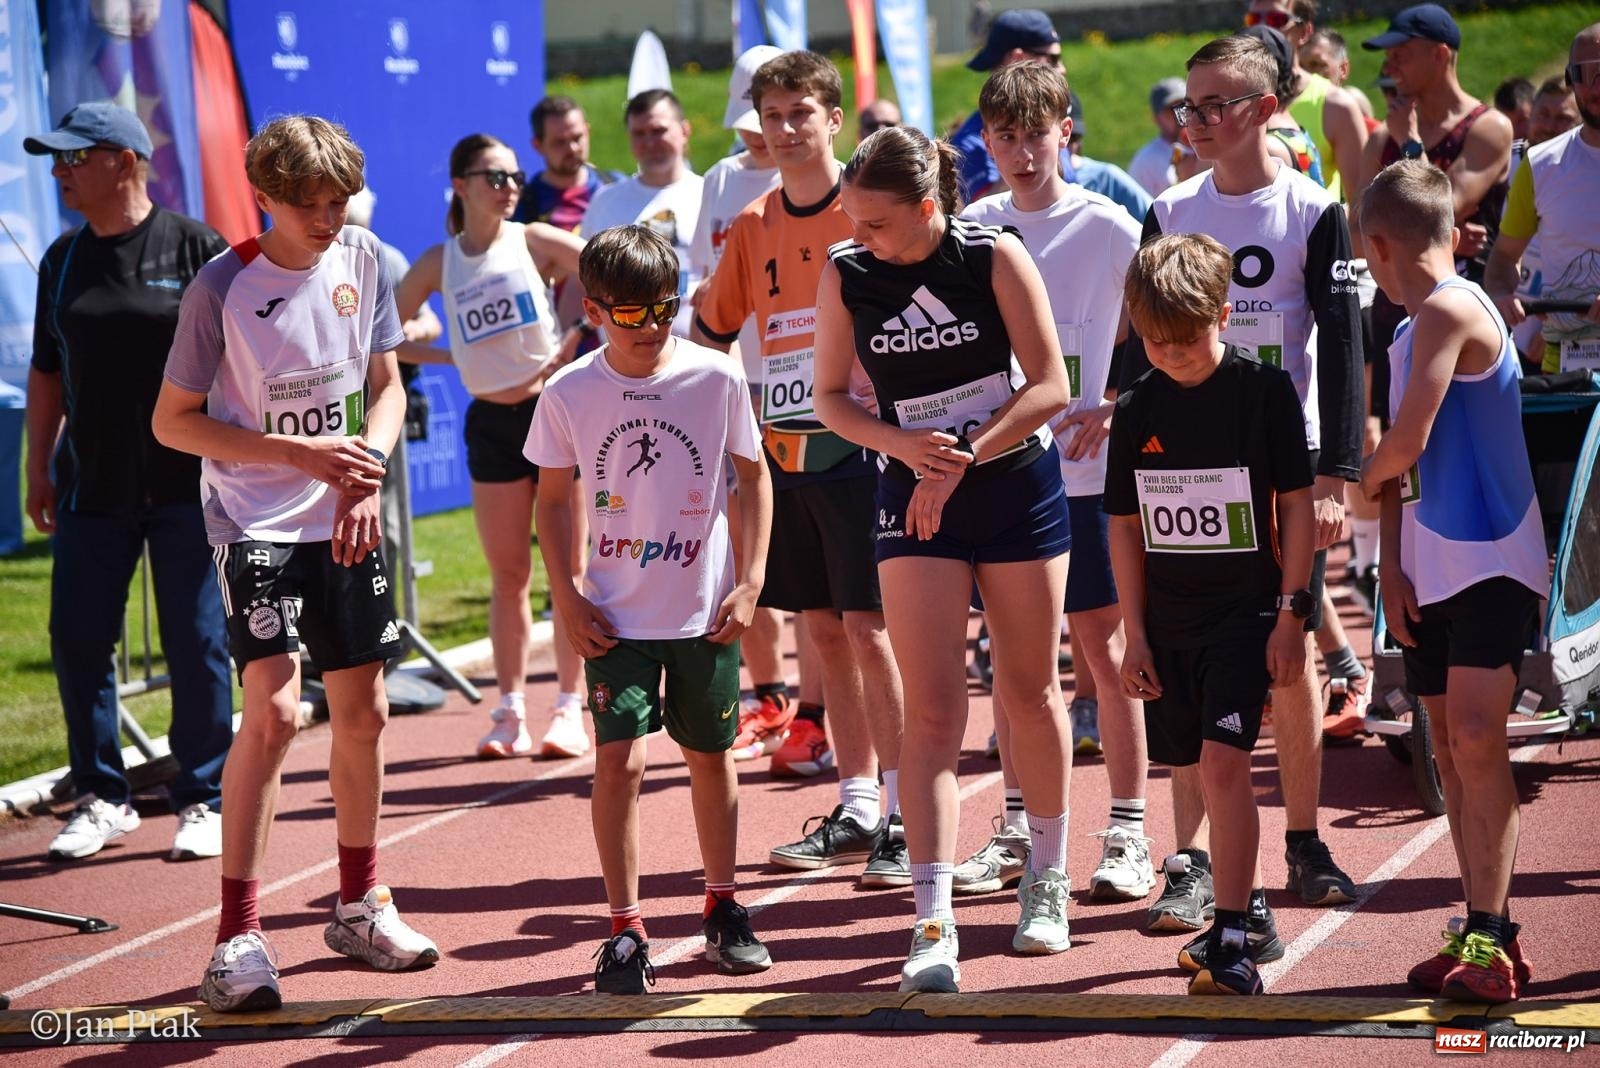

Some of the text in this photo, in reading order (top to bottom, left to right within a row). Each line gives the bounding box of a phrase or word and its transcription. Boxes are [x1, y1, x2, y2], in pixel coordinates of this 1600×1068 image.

[765, 257, 780, 298] 1
[466, 298, 515, 331] 062
[1230, 317, 1259, 327] GRANIC
[870, 321, 979, 354] adidas
[268, 370, 345, 393] XVIII BIEG BEZ GRANIC
[268, 388, 312, 402] 3MAJA2026
[903, 385, 985, 415] XVIII BIEG BEZ GRANIC
[906, 407, 948, 423] 3MAJA2026
[277, 400, 342, 437] 005
[596, 418, 703, 480] INTERNATIONAL TOURNAMENT
[1143, 474, 1223, 485] XVIII BIEG BEZ GRANIC
[1144, 485, 1184, 494] 3MAJA2026
[1153, 505, 1222, 537] 008
[599, 531, 701, 568] trophy
[1569, 641, 1599, 663] Qeridor
